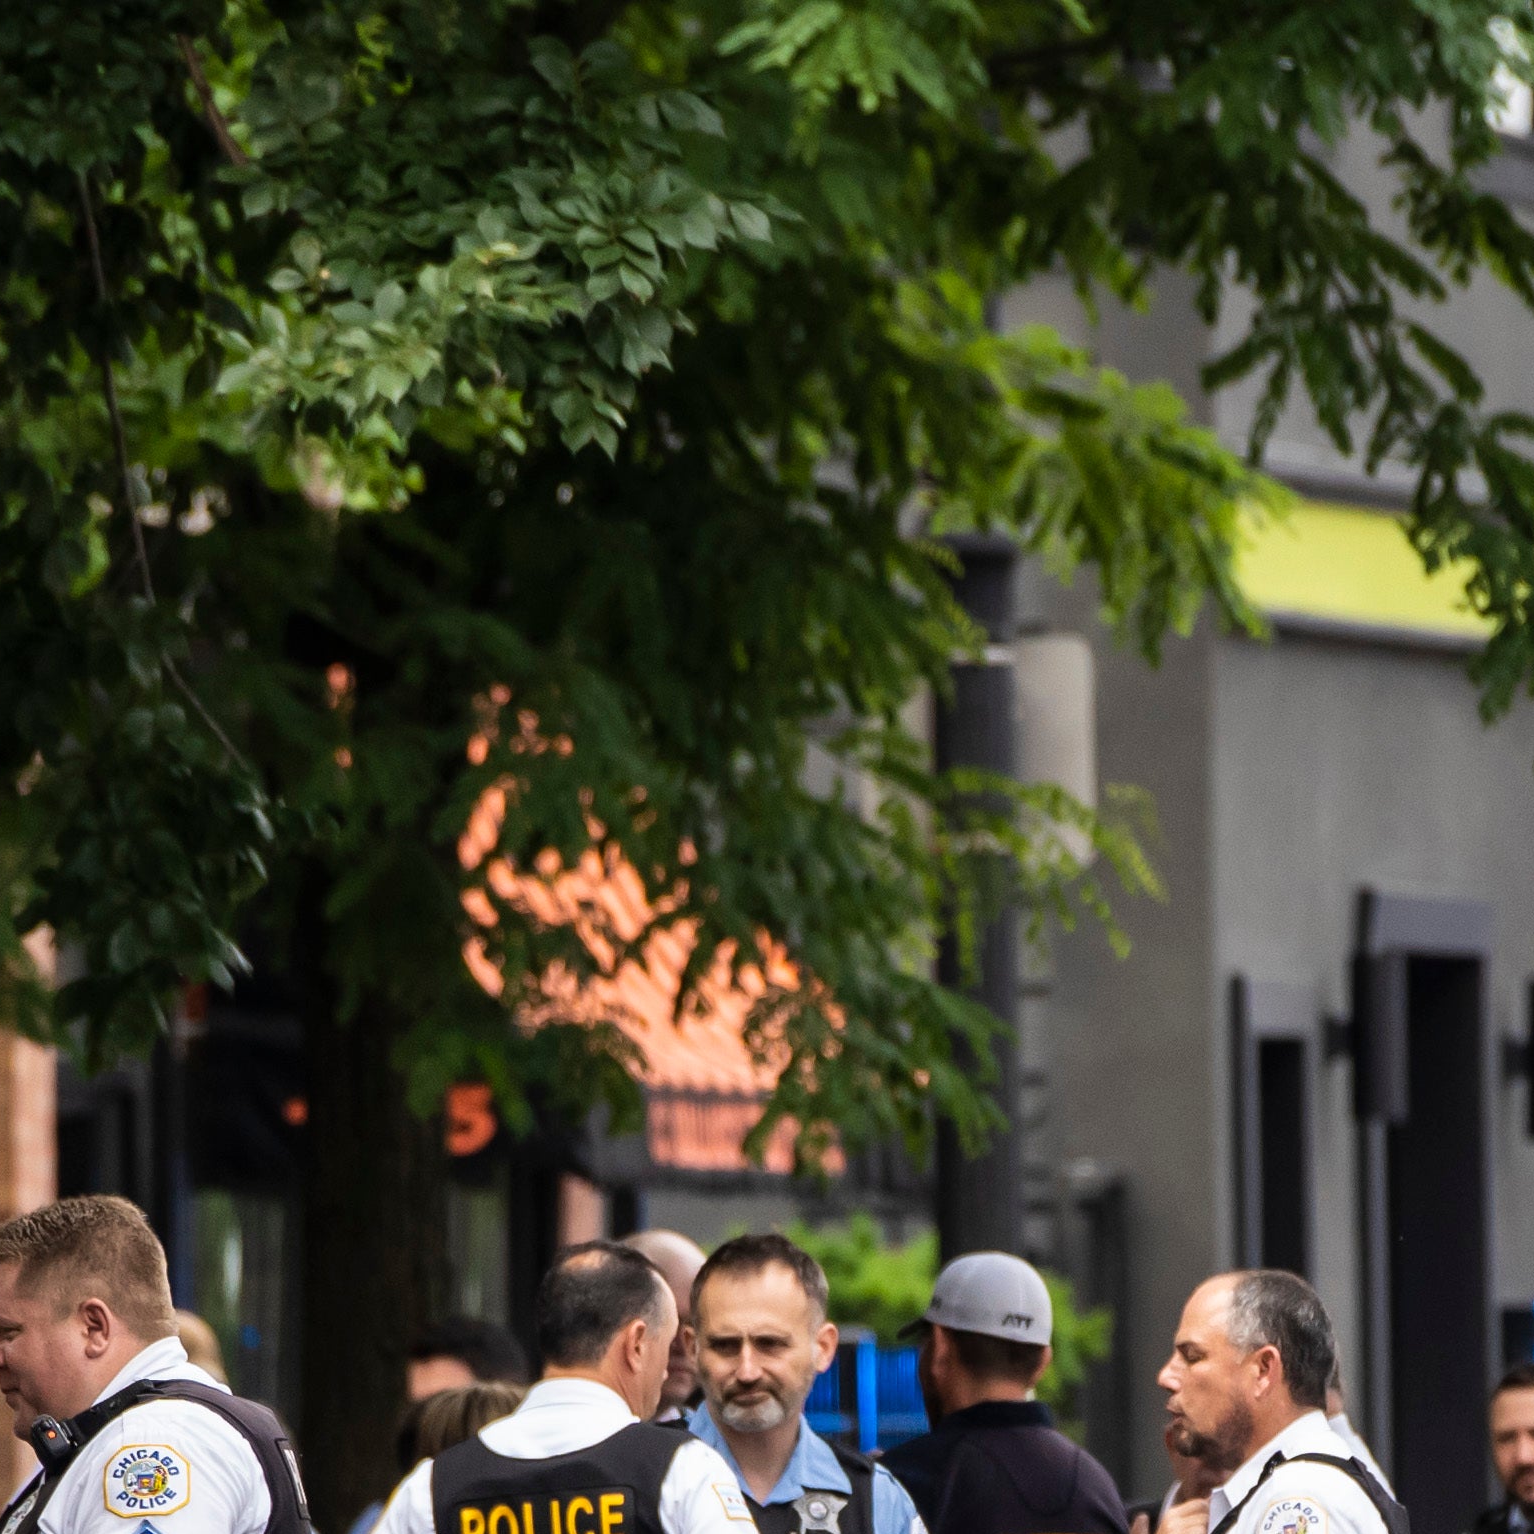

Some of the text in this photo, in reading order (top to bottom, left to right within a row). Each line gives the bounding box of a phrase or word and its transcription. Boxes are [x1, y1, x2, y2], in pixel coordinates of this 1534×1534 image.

[113, 1449, 180, 1479] CHICAGO
[116, 1487, 177, 1510] POLICE
[1264, 1502, 1319, 1531] CHICAGO
